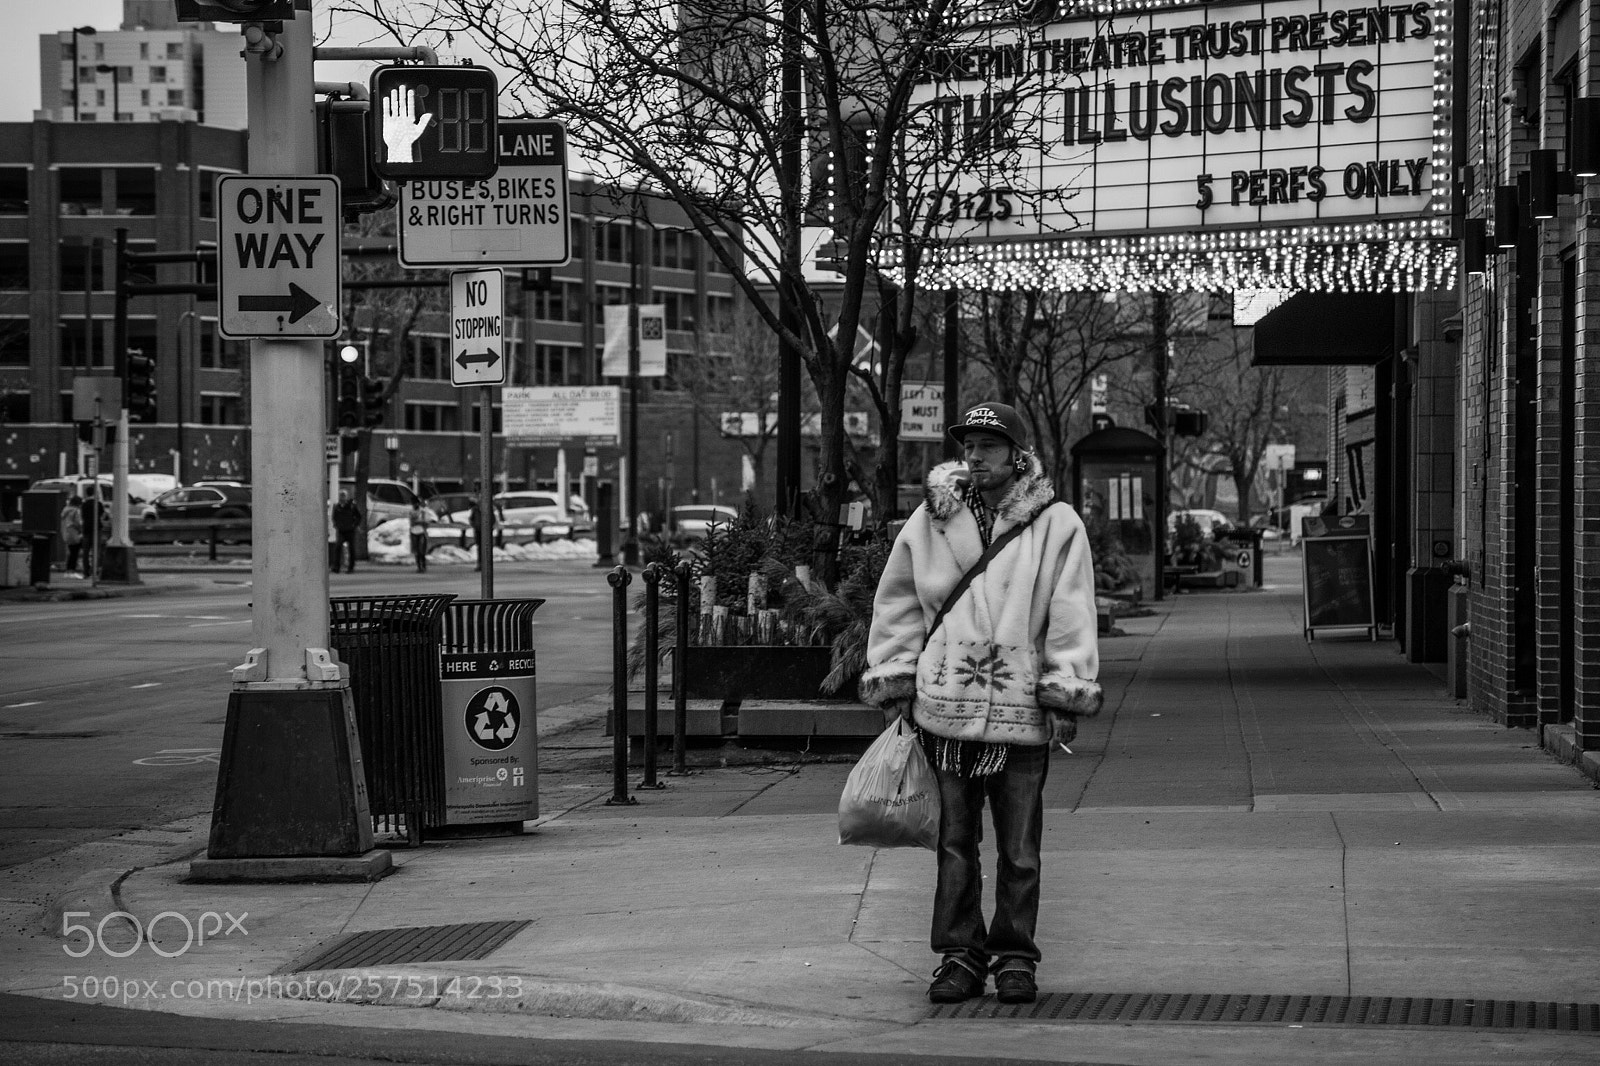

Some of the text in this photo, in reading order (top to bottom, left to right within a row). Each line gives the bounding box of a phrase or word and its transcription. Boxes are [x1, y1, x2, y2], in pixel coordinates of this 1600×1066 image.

[1032, 28, 1166, 78] THEATRE
[1169, 18, 1267, 63] TRUST
[1271, 2, 1432, 54] PRESENTS
[935, 59, 1376, 156] THE ILLUSIONISTS
[499, 134, 555, 157] LANE
[498, 177, 556, 199] BIKES
[1196, 174, 1213, 210] 5
[1231, 165, 1328, 206] PERFS
[1343, 157, 1429, 200] ONLY
[236, 187, 323, 224] ONE
[427, 204, 486, 226] RIGHT
[493, 204, 560, 225] TURNS
[234, 233, 325, 269] WAY
[466, 280, 488, 308] NO
[455, 315, 501, 340] STOPPING
[912, 406, 938, 418] MUST
[903, 422, 923, 433] TURN
[446, 661, 477, 673] HERE
[470, 757, 509, 767] Sponsored
[457, 776, 496, 784] Ameriprise
